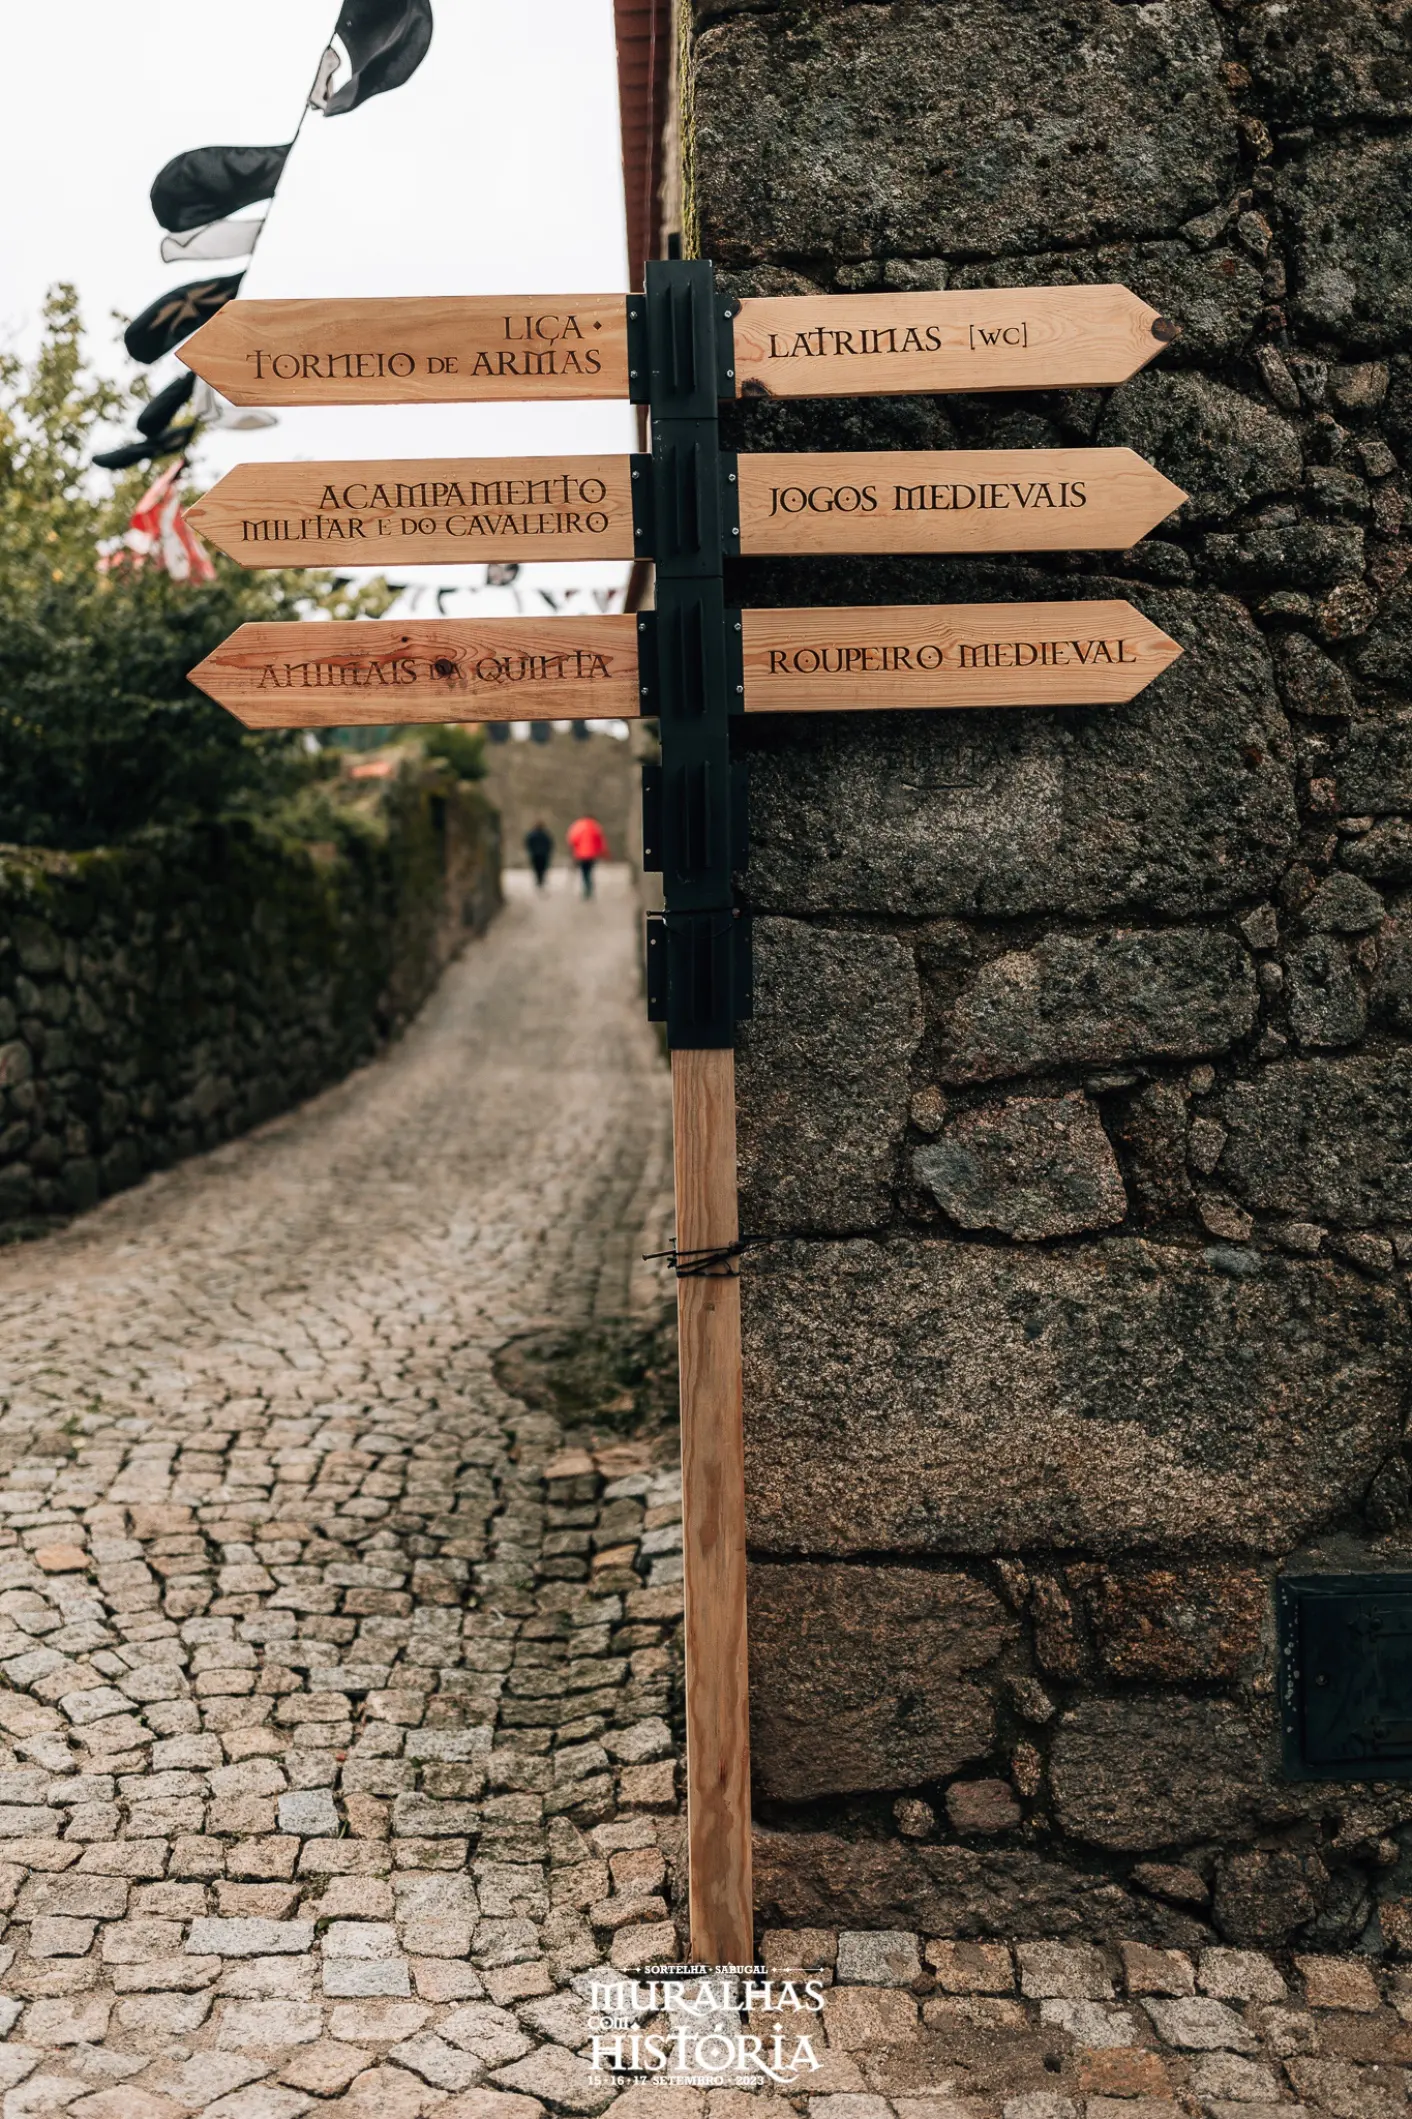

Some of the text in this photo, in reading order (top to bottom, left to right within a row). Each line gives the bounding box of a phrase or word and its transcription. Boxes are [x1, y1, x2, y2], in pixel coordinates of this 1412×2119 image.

[503, 315, 585, 346] LIÇA
[768, 325, 943, 359] LATRINAS
[246, 348, 602, 380] TORNEIO DE ARMAS
[318, 474, 608, 510] ACAMPAMENTO
[768, 481, 1087, 517] JOGOS MEDIEVAIS
[241, 511, 609, 542] MILITAR E DO CAVALEIRO
[256, 658, 418, 690] ANIMAIS
[475, 649, 613, 684] QUINTA
[768, 639, 1137, 675] ROUPEIRO MEDIEVAL
